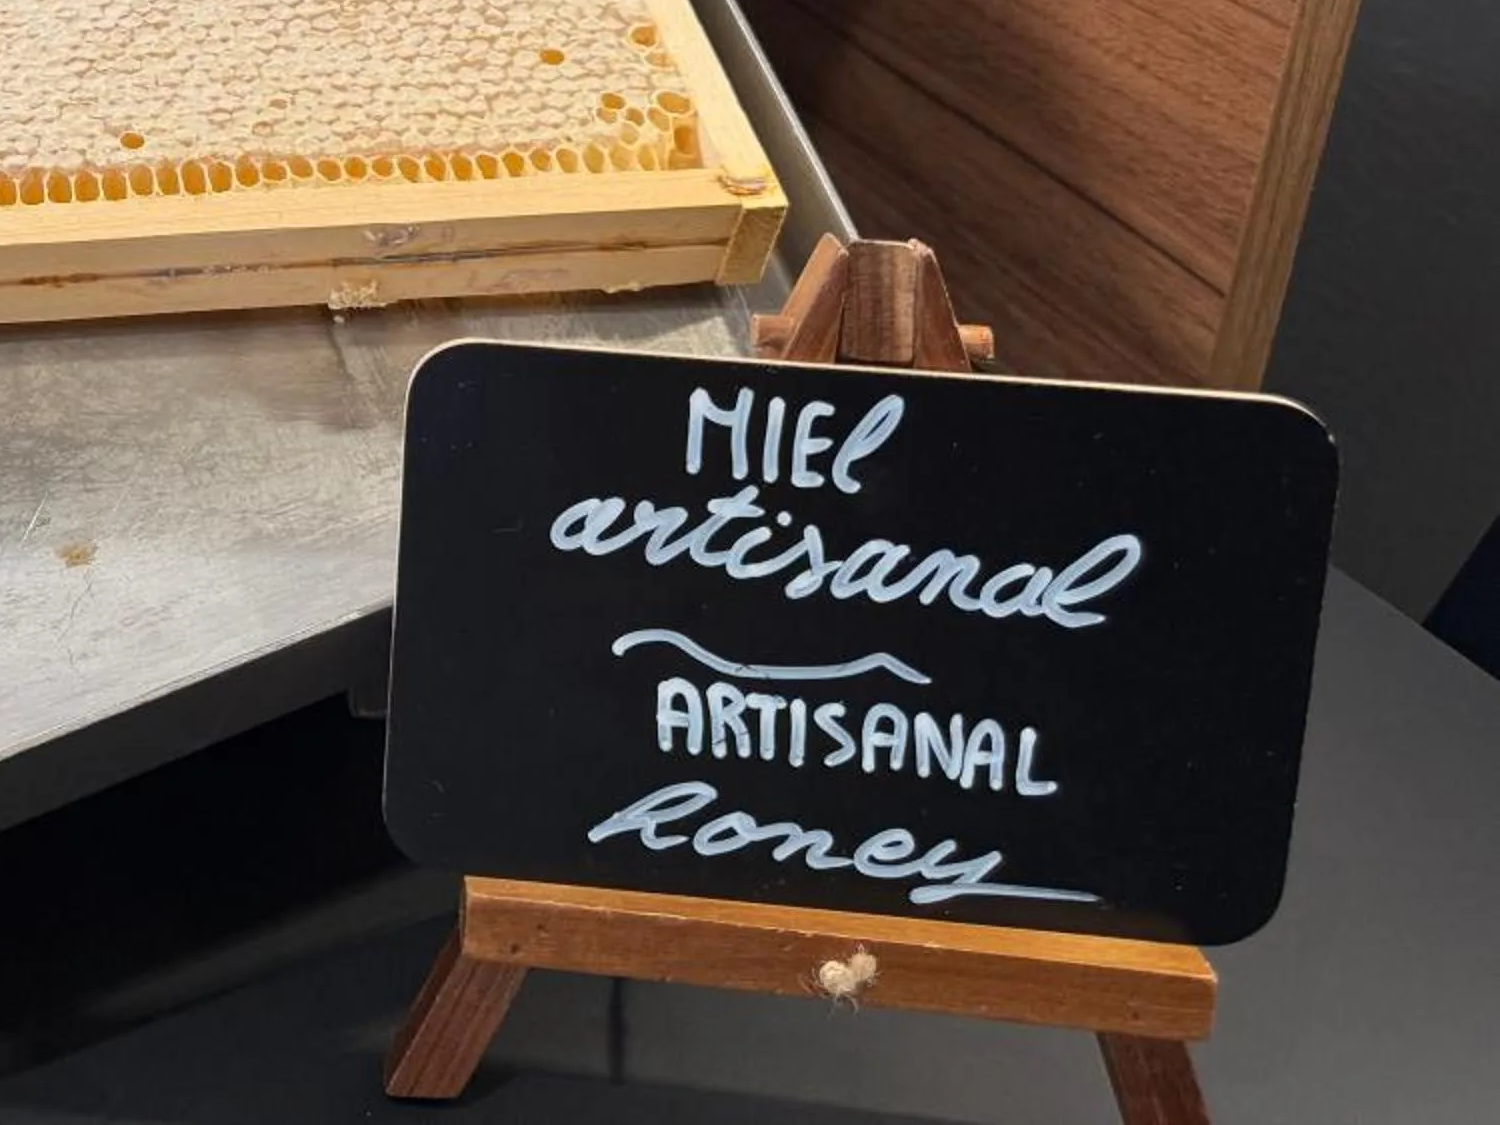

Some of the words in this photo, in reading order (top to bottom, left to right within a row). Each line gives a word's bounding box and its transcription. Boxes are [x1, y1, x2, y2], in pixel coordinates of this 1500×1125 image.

[549, 484, 1144, 629] artisanal
[655, 678, 1060, 797] ARTISANAL
[587, 781, 1102, 903] honey
